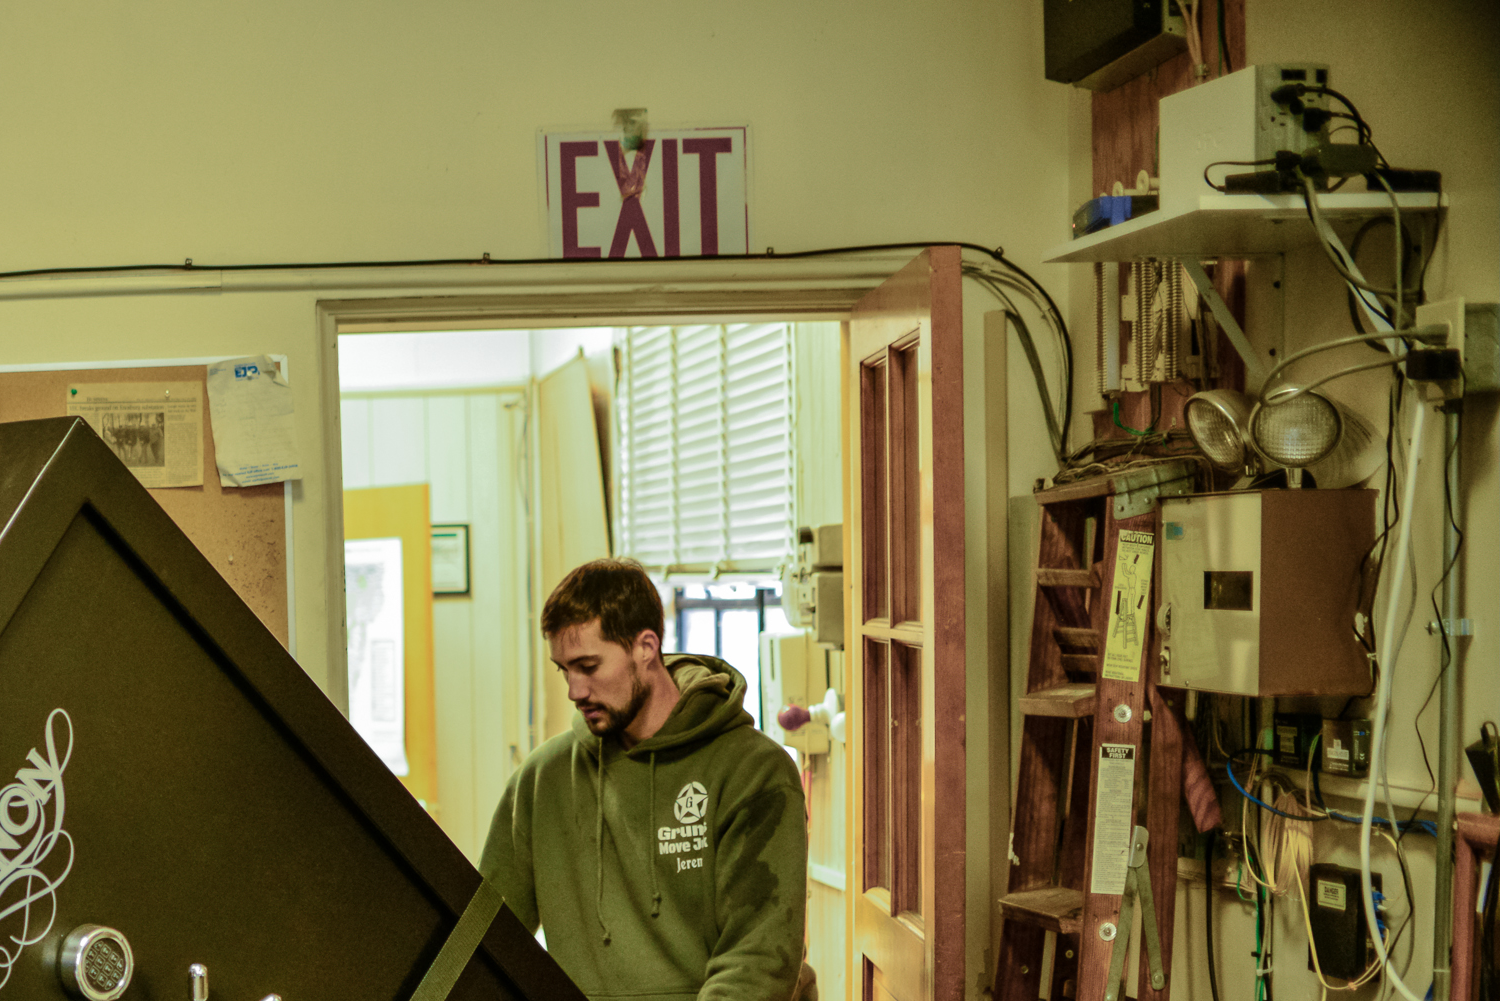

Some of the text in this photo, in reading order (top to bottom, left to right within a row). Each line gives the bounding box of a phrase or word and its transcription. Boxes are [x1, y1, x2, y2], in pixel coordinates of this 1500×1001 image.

[559, 137, 733, 259] EXIT
[1120, 533, 1153, 545] CAUTION
[659, 841, 691, 855] Move
